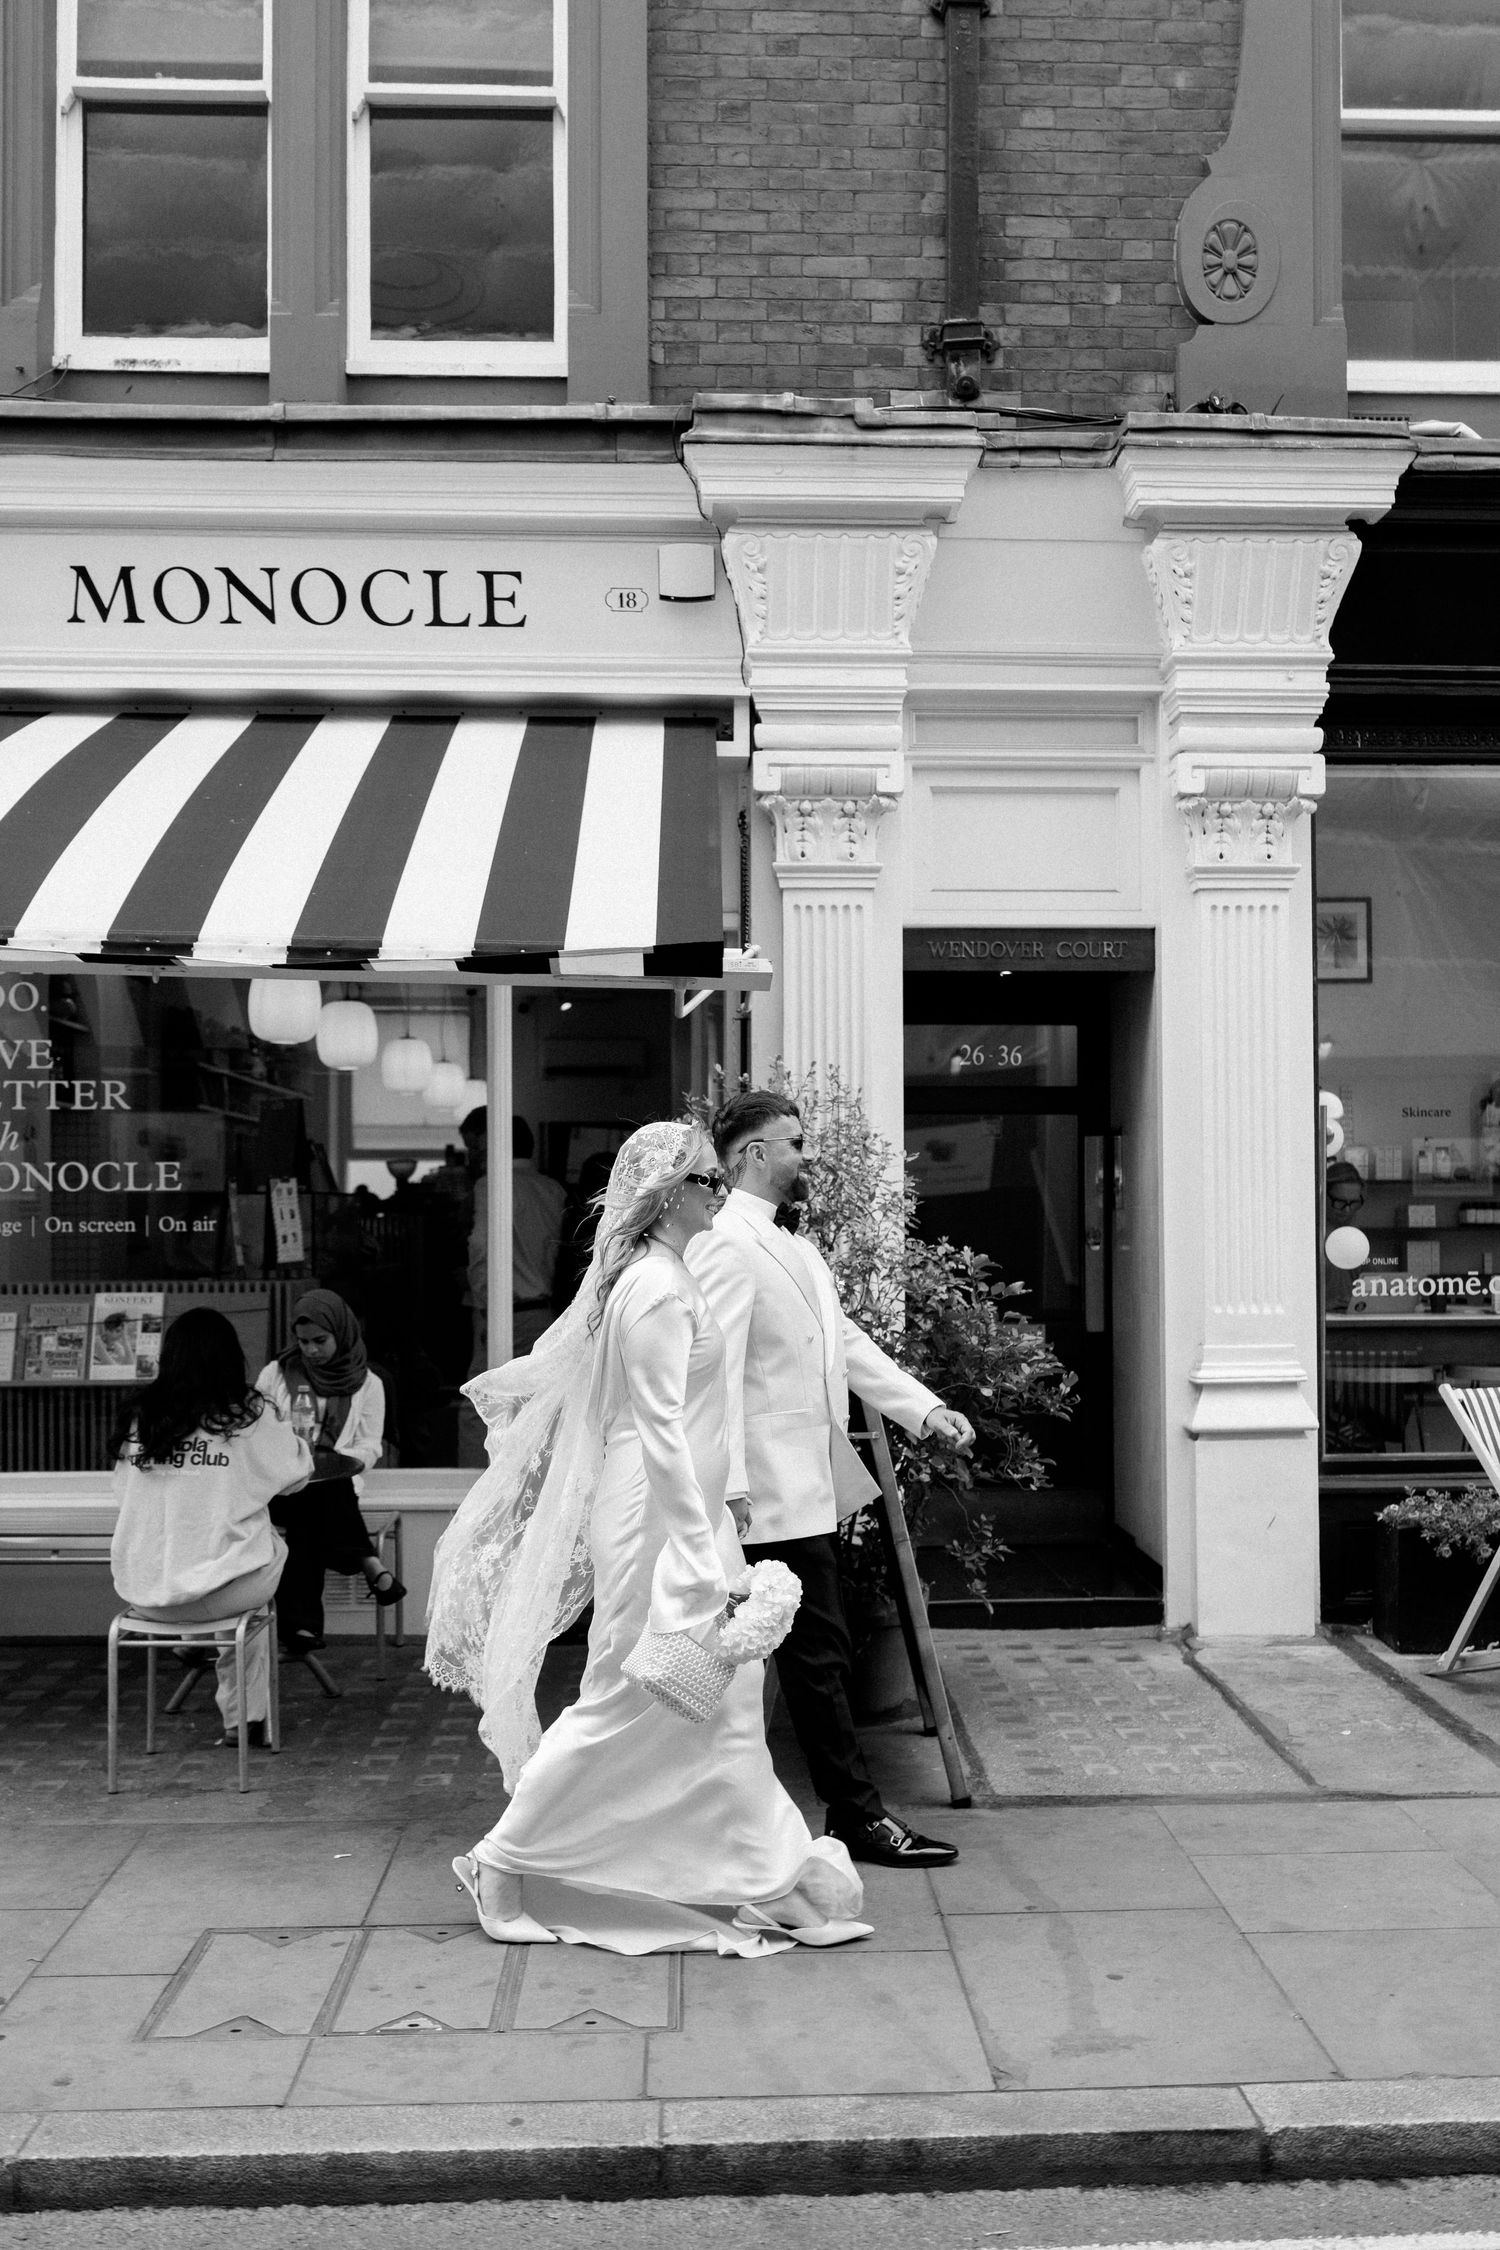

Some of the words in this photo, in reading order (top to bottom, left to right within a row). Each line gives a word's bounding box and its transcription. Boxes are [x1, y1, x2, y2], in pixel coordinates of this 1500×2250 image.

[67, 565, 527, 627] MONOCLE
[619, 592, 637, 608] 18
[927, 941, 1044, 958] WENDOVER
[1056, 941, 1127, 958] COURT
[0, 982, 47, 1012] O.
[0, 1080, 131, 1110] TTER
[1401, 1106, 1451, 1118] Skincare
[0, 1221, 22, 1237] ge
[45, 1216, 73, 1233] On
[79, 1218, 136, 1233] screen
[158, 1216, 187, 1233] On
[193, 1216, 217, 1232] air
[1372, 1257, 1399, 1266] ONLINE
[190, 1452, 230, 1467] club
